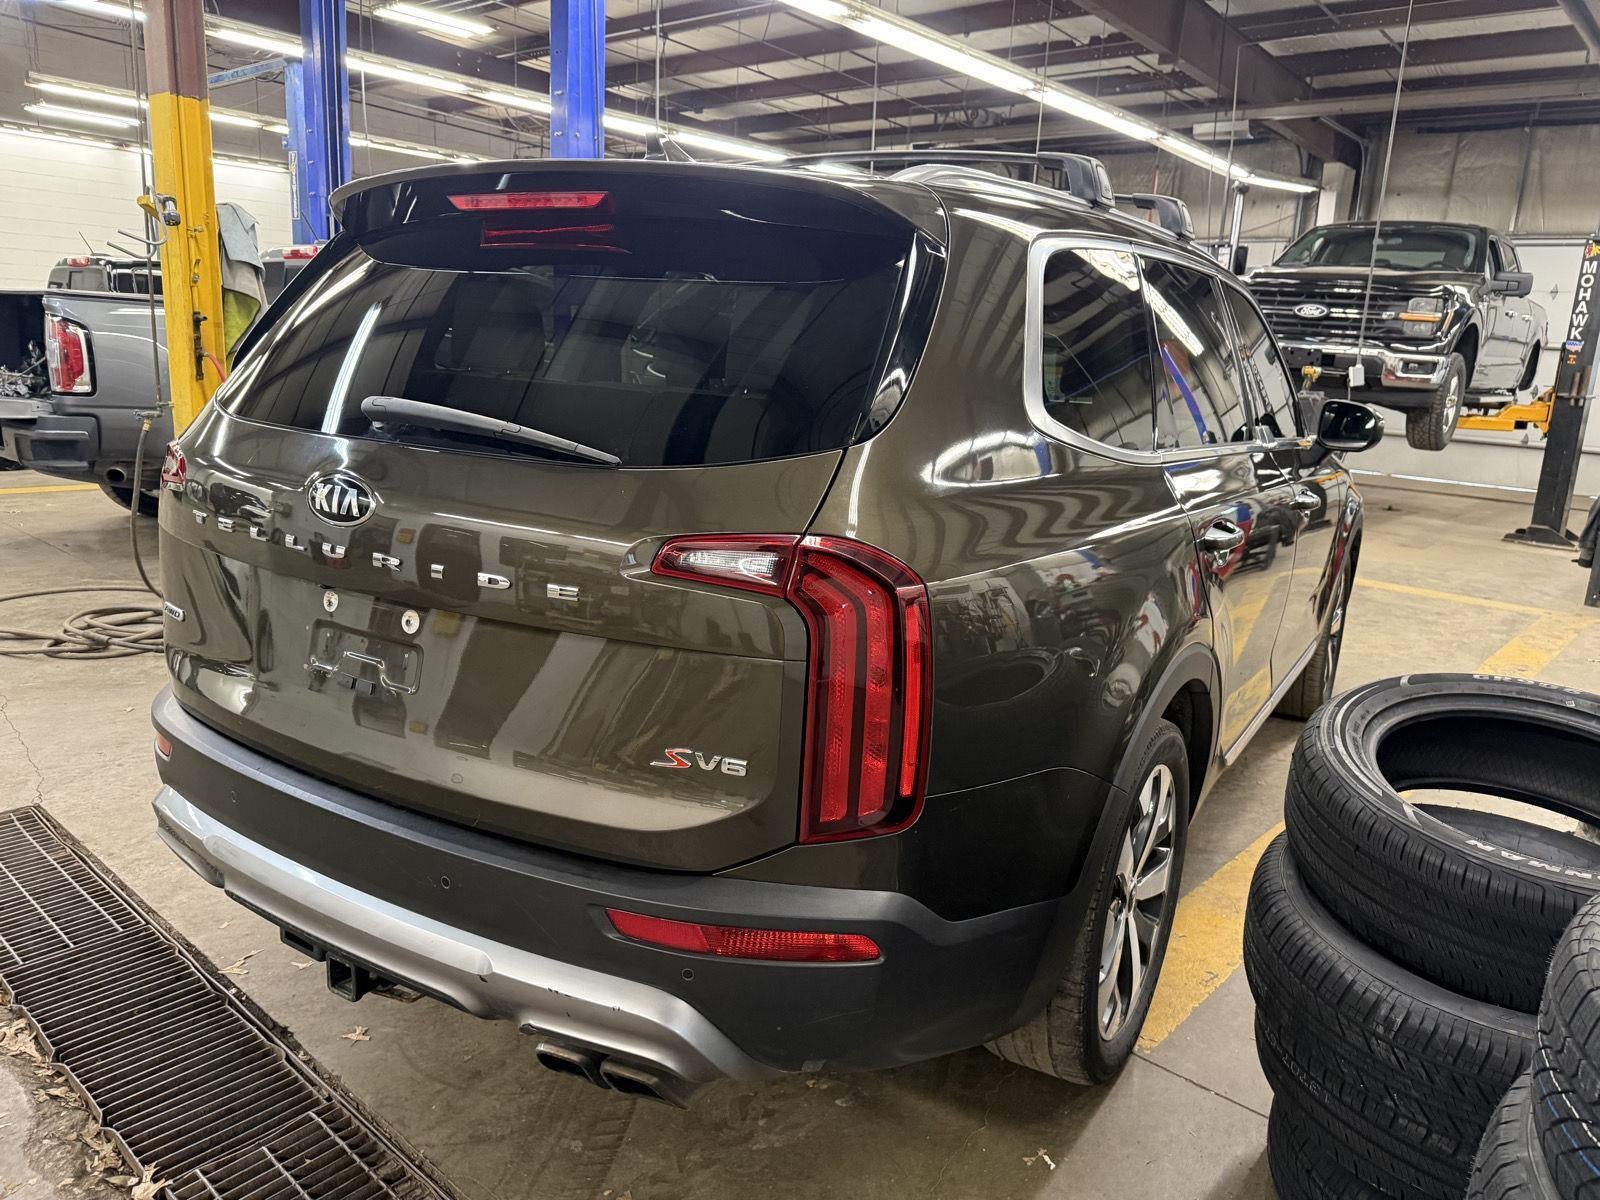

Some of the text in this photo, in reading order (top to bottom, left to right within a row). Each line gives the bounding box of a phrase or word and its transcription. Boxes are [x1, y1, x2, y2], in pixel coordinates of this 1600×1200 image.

[1299, 304, 1322, 316] Ford
[1570, 260, 1597, 340] MOHAWK
[314, 482, 360, 517] KIA
[192, 509, 580, 602] TELLURIDE
